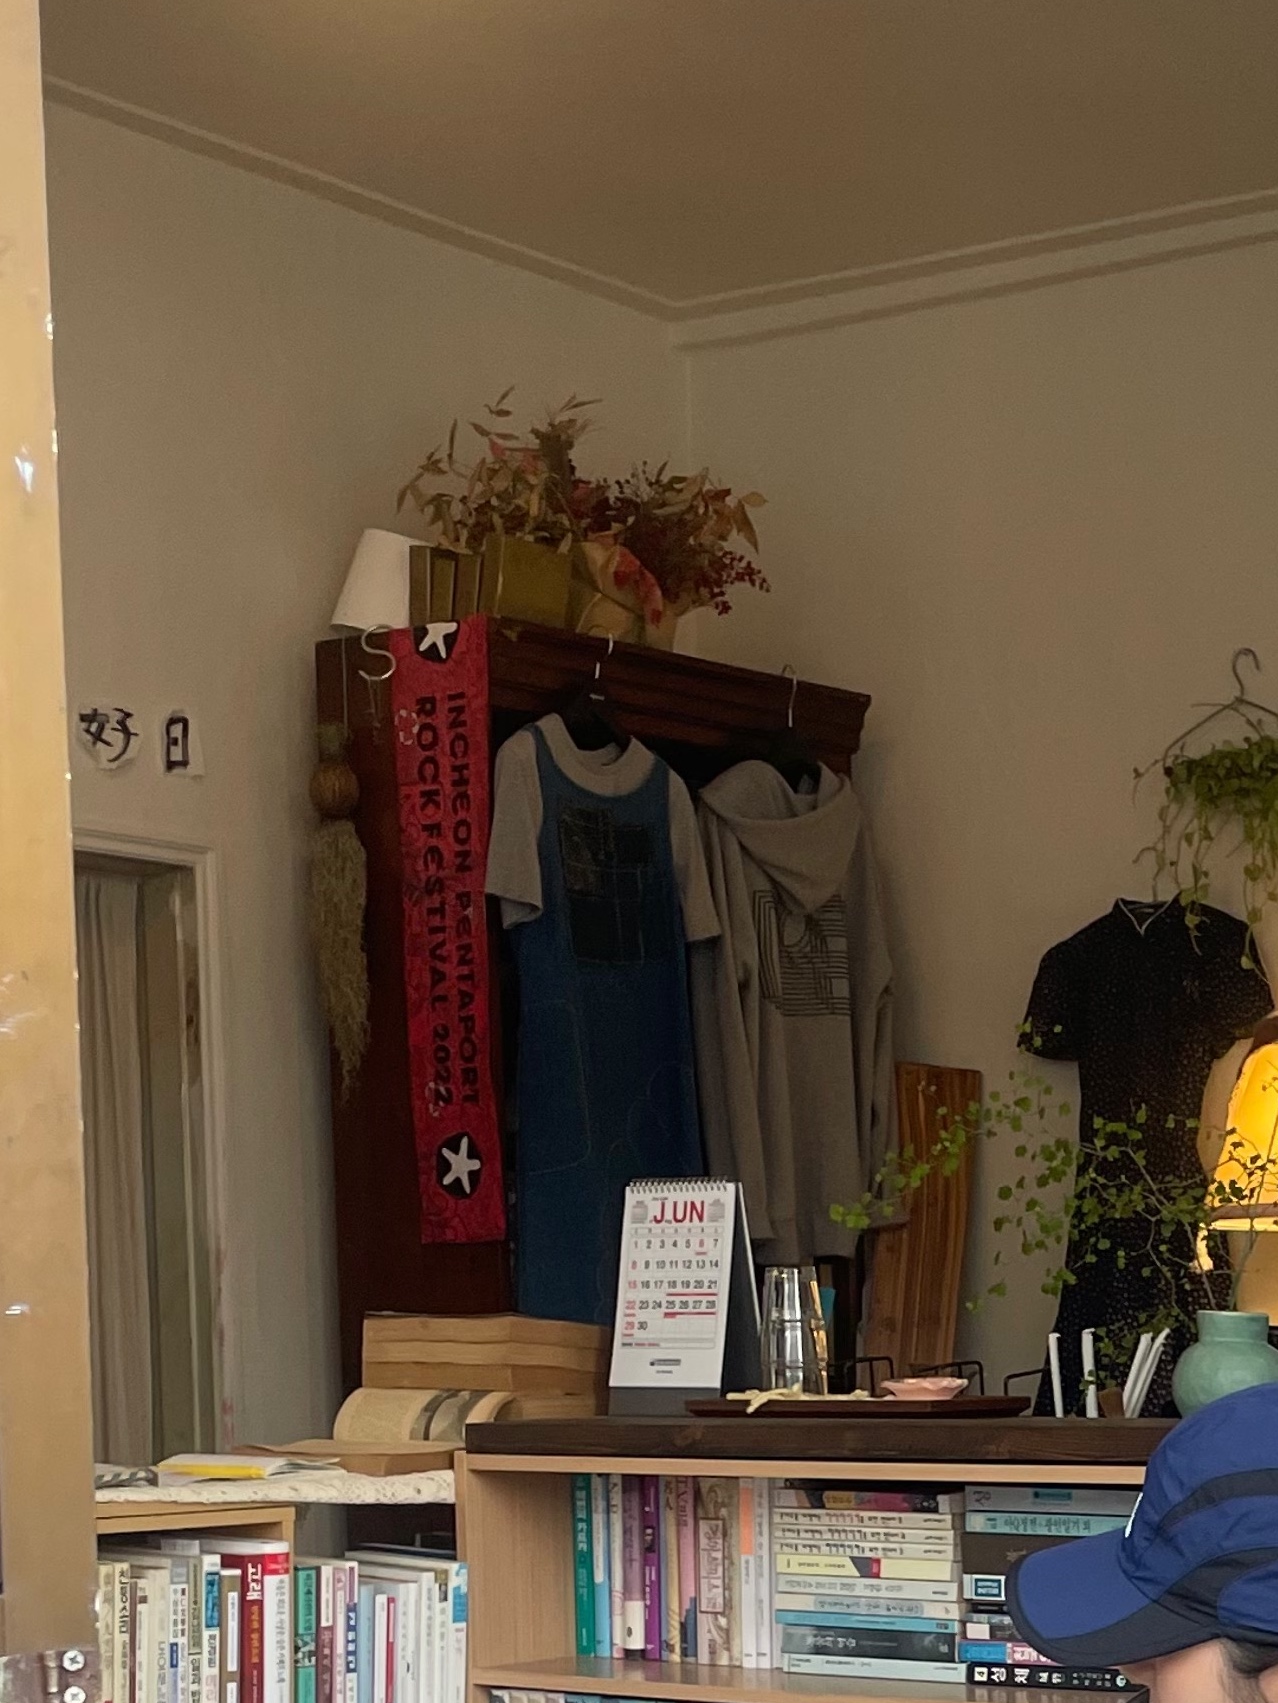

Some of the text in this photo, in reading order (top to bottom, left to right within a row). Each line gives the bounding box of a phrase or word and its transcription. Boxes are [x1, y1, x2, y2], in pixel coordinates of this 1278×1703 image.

[415, 695, 454, 1105] ROCK FESTIVAL 2022
[447, 690, 480, 1104] INCHEON PENTAPORT
[653, 1200, 705, 1224] JUN
[634, 1239, 638, 1249] 1
[646, 1239, 652, 1249] 2
[659, 1239, 665, 1249] 3
[672, 1239, 678, 1249] 4
[685, 1239, 691, 1249] 5
[712, 1239, 719, 1249] 7
[644, 1260, 650, 1269] 9
[656, 1260, 666, 1269] 10
[669, 1260, 678, 1269] 11
[682, 1260, 692, 1269] 12
[697, 1260, 706, 1269] 13
[709, 1260, 719, 1269] 14
[641, 1280, 650, 1289] 16
[654, 1280, 664, 1289] 17
[667, 1280, 677, 1289] 18
[681, 1280, 690, 1289] 19
[693, 1280, 704, 1289] 20
[707, 1280, 718, 1289] 21
[638, 1300, 649, 1310] 23
[652, 1300, 662, 1310] 24
[666, 1300, 676, 1310] 25
[679, 1300, 689, 1310] 26
[692, 1300, 703, 1310] 27
[705, 1300, 717, 1310] 28
[637, 1321, 648, 1331] 30
[245, 1562, 263, 1601] 고래
[189, 1658, 201, 1685] 일과
